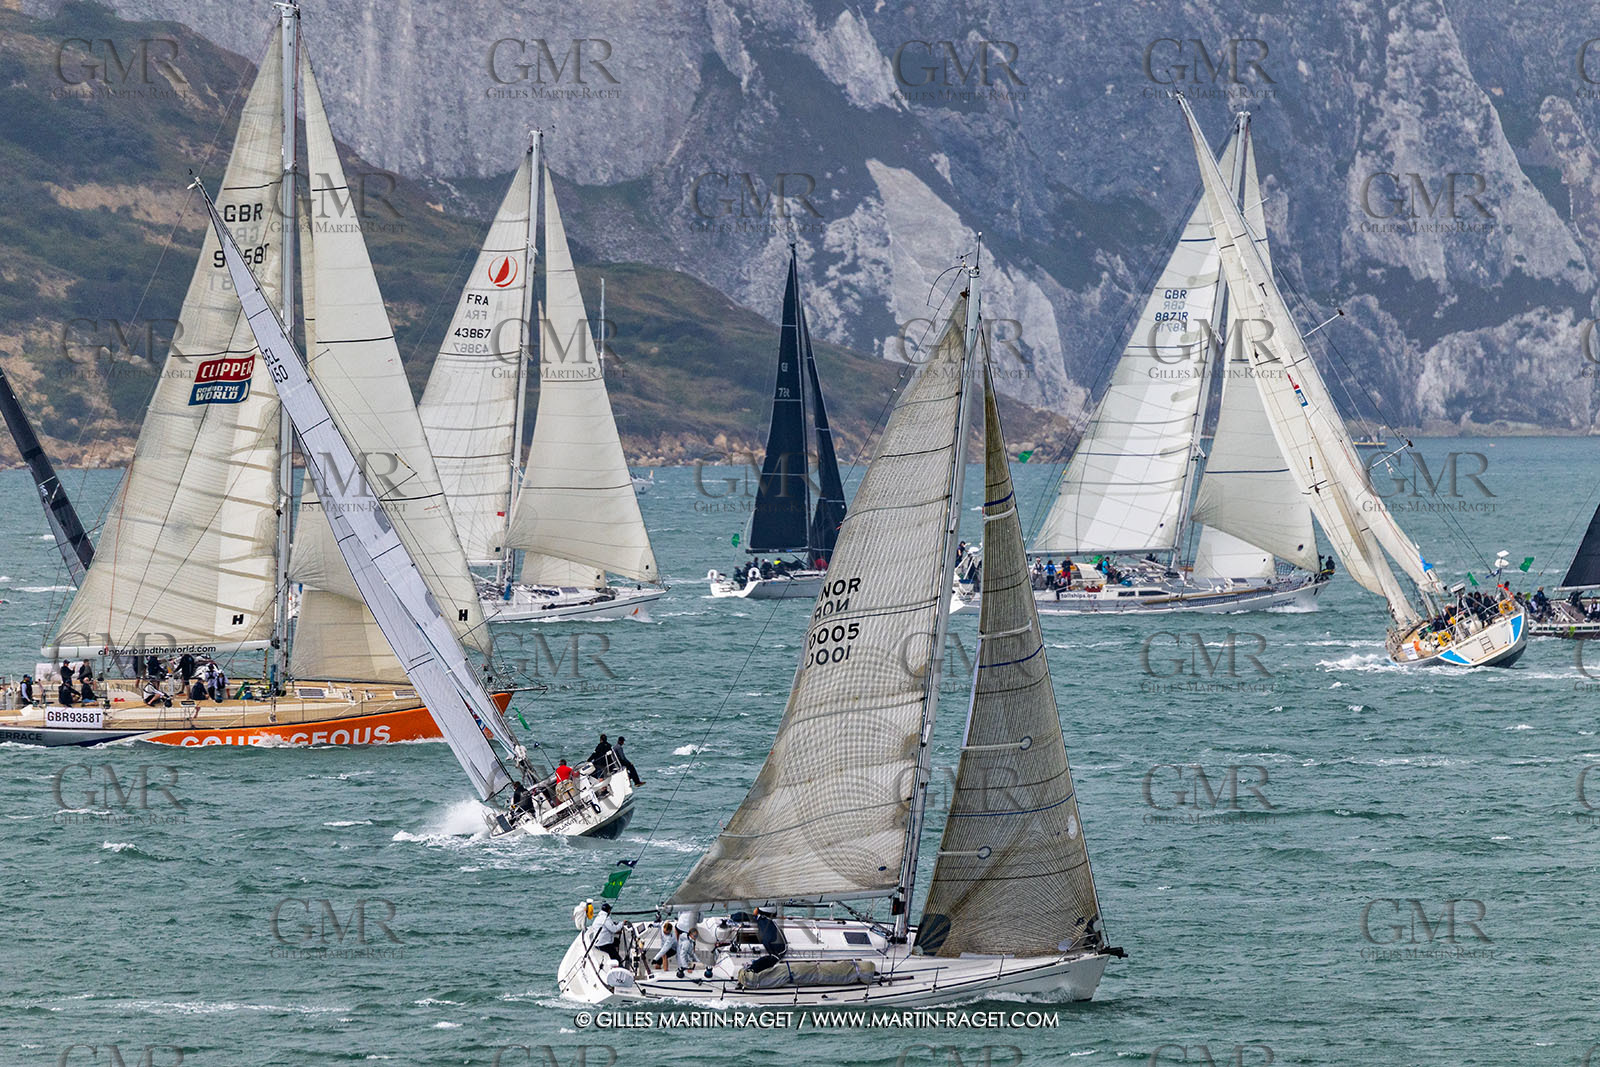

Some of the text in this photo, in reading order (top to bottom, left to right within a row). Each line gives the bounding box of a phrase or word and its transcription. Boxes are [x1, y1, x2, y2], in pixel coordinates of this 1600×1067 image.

[224, 203, 263, 222] GBR
[213, 243, 270, 268] 958T
[466, 294, 489, 306] FRA
[1164, 289, 1187, 299] GBR
[1155, 311, 1189, 322] 8871R
[454, 327, 491, 339] 43867
[201, 360, 253, 379] CLIPPER
[195, 391, 239, 401] WORLD
[821, 577, 861, 601] NOR
[232, 613, 244, 625] H
[458, 609, 468, 621] H
[47, 711, 101, 723] GBR9358T
